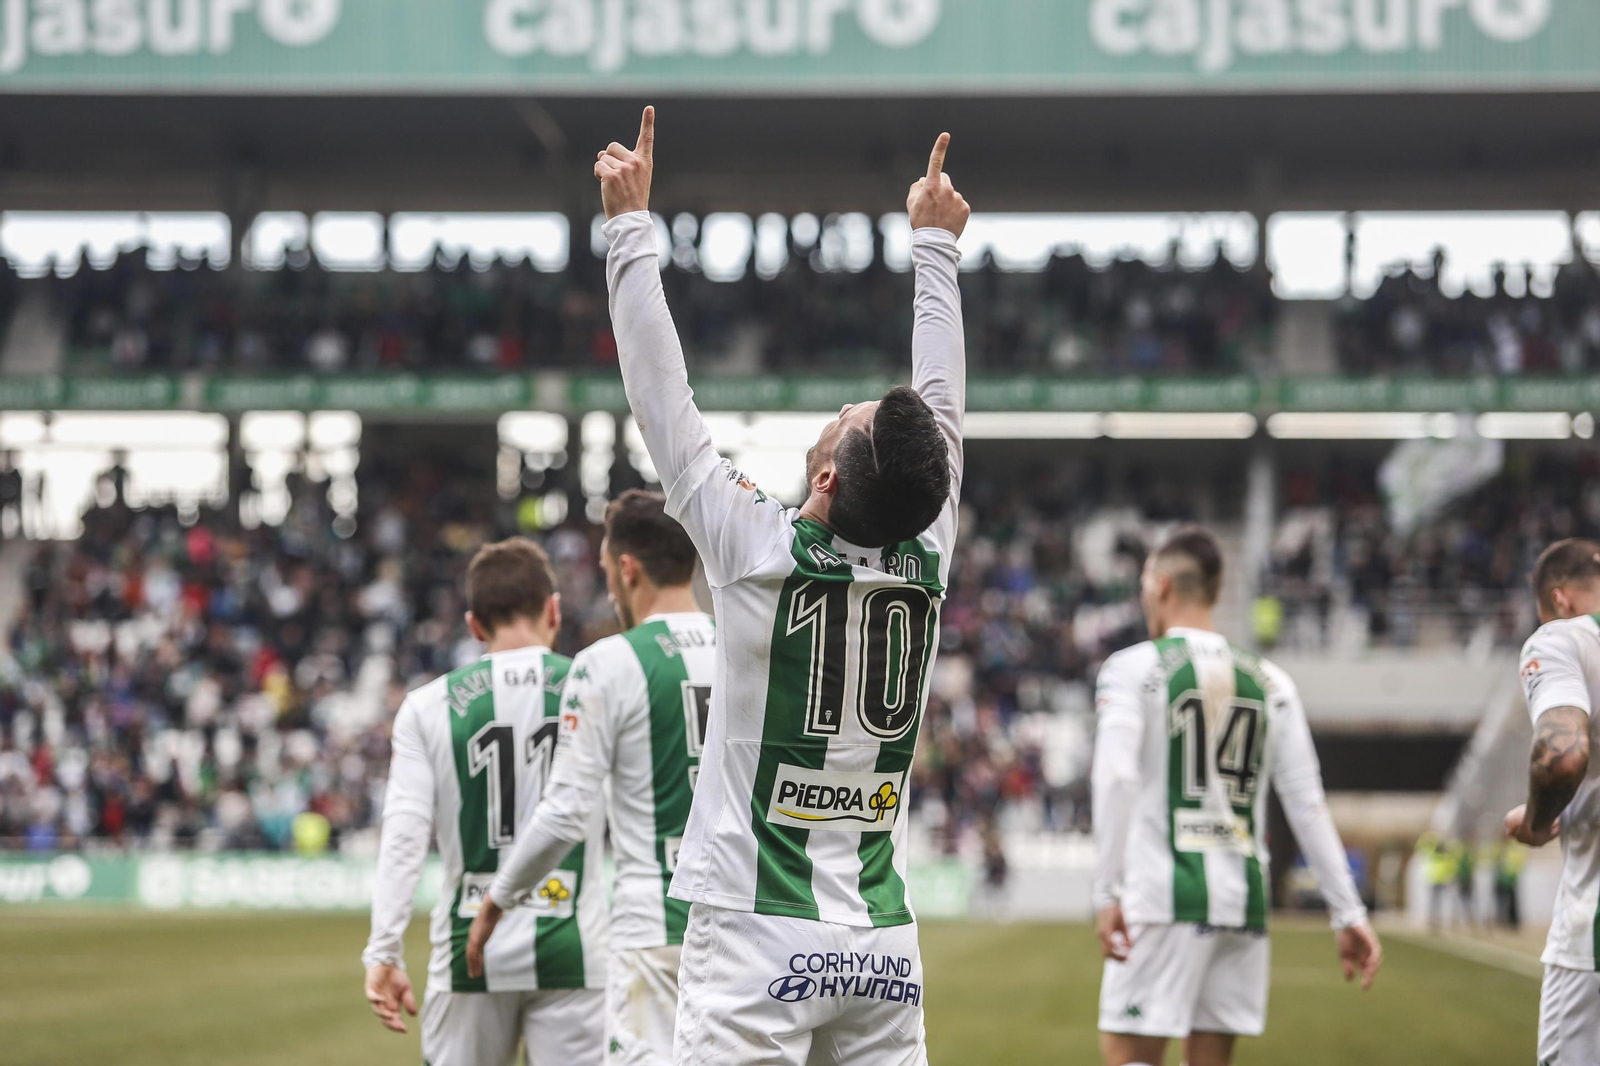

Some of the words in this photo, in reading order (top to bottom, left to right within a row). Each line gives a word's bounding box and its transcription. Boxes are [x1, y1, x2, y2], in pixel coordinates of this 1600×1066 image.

[654, 628, 717, 658] AGU
[786, 580, 932, 742] 10
[1169, 688, 1264, 807] 14
[789, 952, 911, 978] CORHYUND
[819, 975, 921, 1007] HYUNDAI
